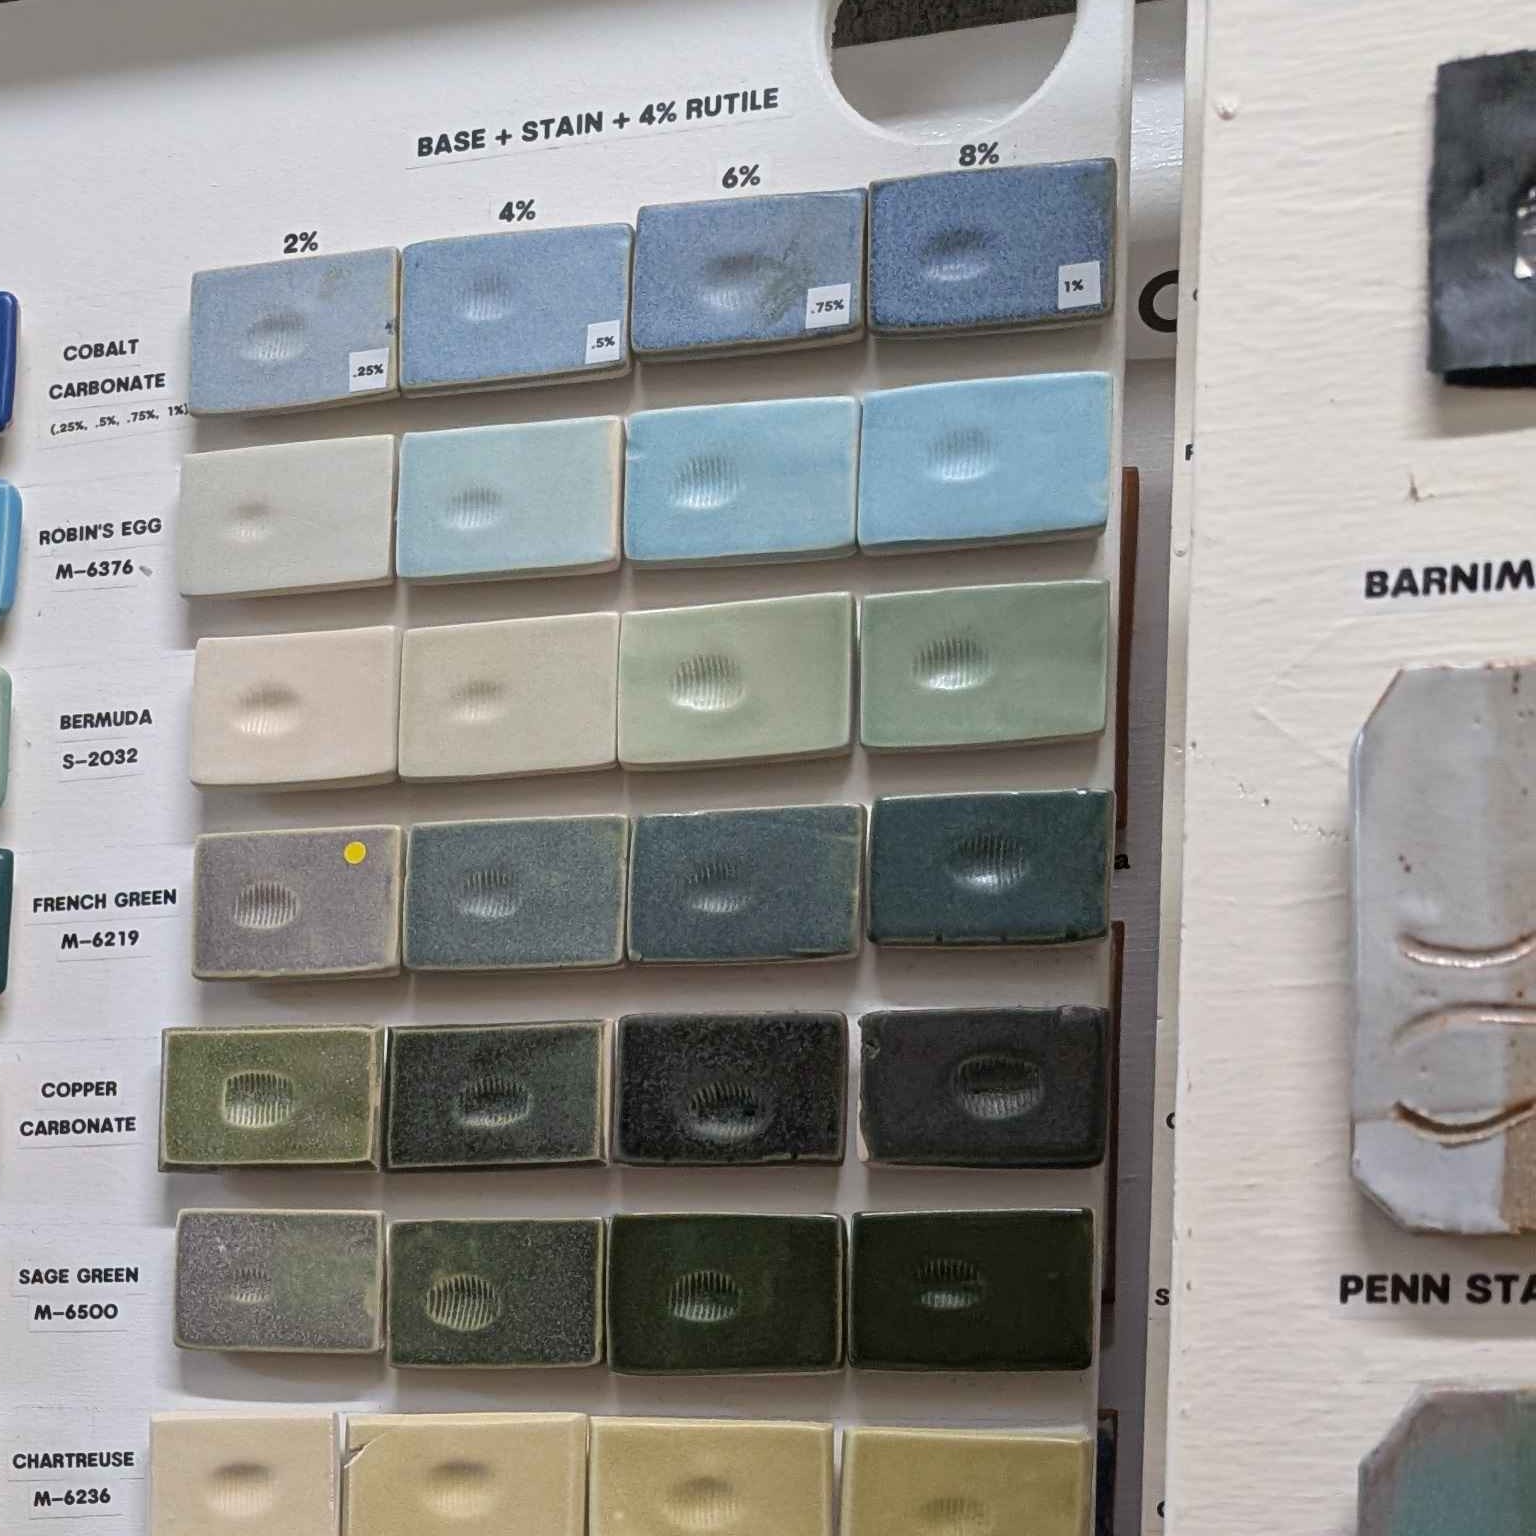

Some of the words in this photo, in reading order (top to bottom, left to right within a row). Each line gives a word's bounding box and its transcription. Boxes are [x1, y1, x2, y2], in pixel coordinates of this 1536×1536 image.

[417, 128, 487, 158] BASE
[494, 128, 513, 146] +
[521, 111, 604, 143] STAIN
[612, 112, 631, 129] +
[638, 101, 678, 126] 4%
[685, 87, 780, 121] RUTILE
[958, 142, 1000, 168] 8%
[721, 164, 761, 189] 6%
[498, 198, 537, 223] 4%
[282, 231, 320, 254] 2%
[1064, 279, 1083, 293] 1%
[809, 297, 845, 315] .75%
[62, 338, 141, 362] COBALT
[590, 334, 616, 350] .5%
[352, 363, 384, 379] .25%
[48, 372, 167, 400] CARBONATE
[39, 522, 115, 546] ROBIN'S
[121, 517, 163, 538] EGG
[59, 708, 153, 731] BERMUDA
[32, 892, 108, 914] FRENCH
[114, 888, 178, 909] GREEN
[41, 1080, 118, 1098] COPPER
[19, 1116, 137, 1137] CARBONATE
[19, 1268, 70, 1285] SAGE
[76, 1266, 140, 1284] GREEN
[1339, 1273, 1451, 1304] PENN
[12, 1451, 136, 1470] CHARTREUSE
